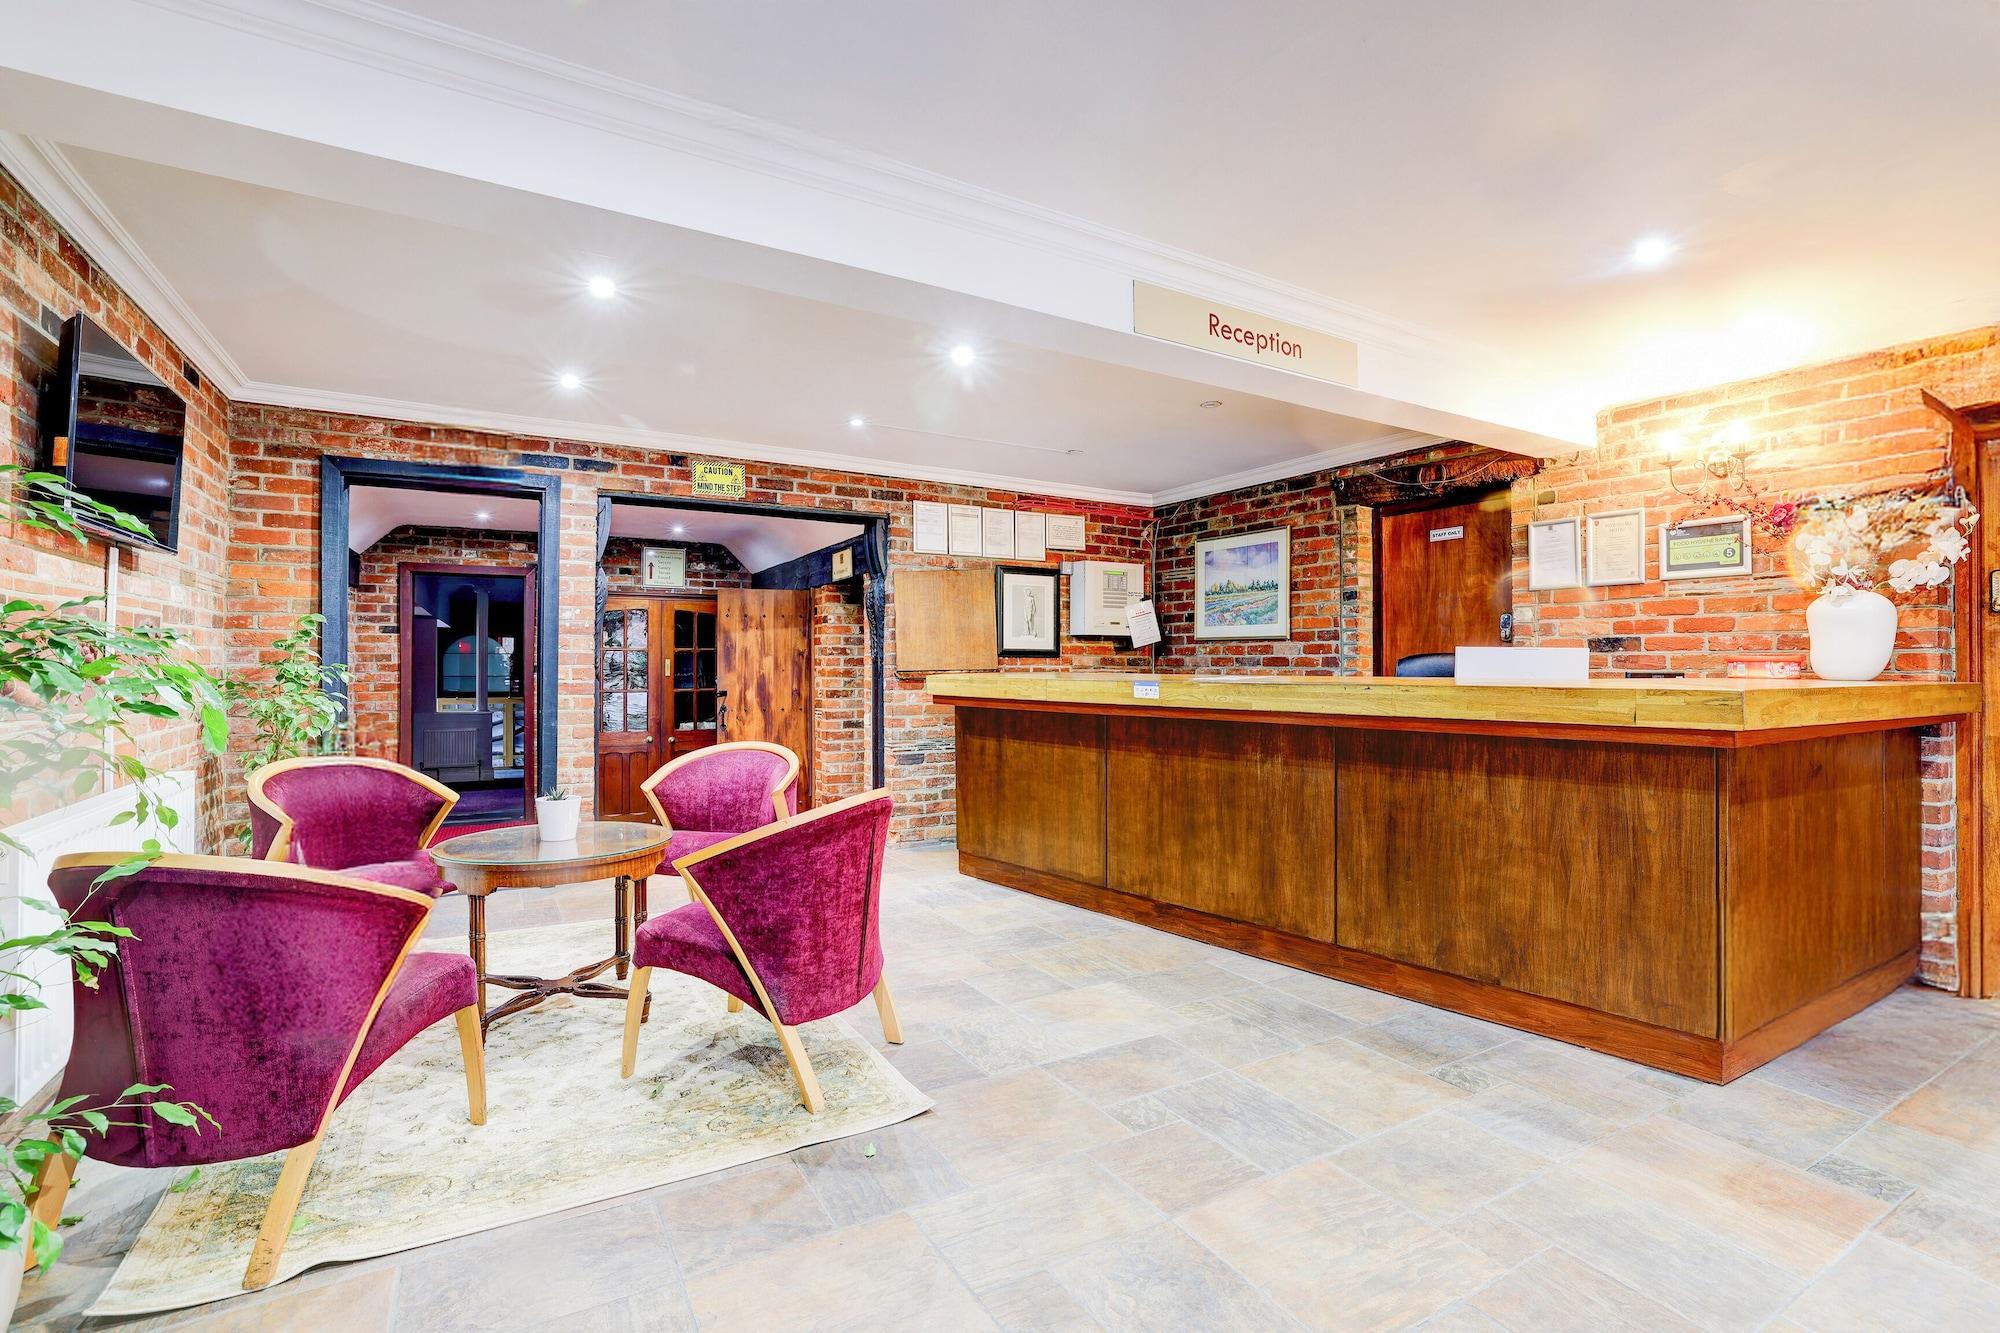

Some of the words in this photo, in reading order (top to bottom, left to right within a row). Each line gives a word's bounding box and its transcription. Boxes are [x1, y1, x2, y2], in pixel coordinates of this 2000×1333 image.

[1208, 312, 1302, 359] Reception
[703, 466, 733, 476] CAUTION
[697, 482, 713, 491] MIND
[714, 483, 725, 492] THE
[726, 484, 742, 493] STEP
[1726, 548, 1734, 557] 5
